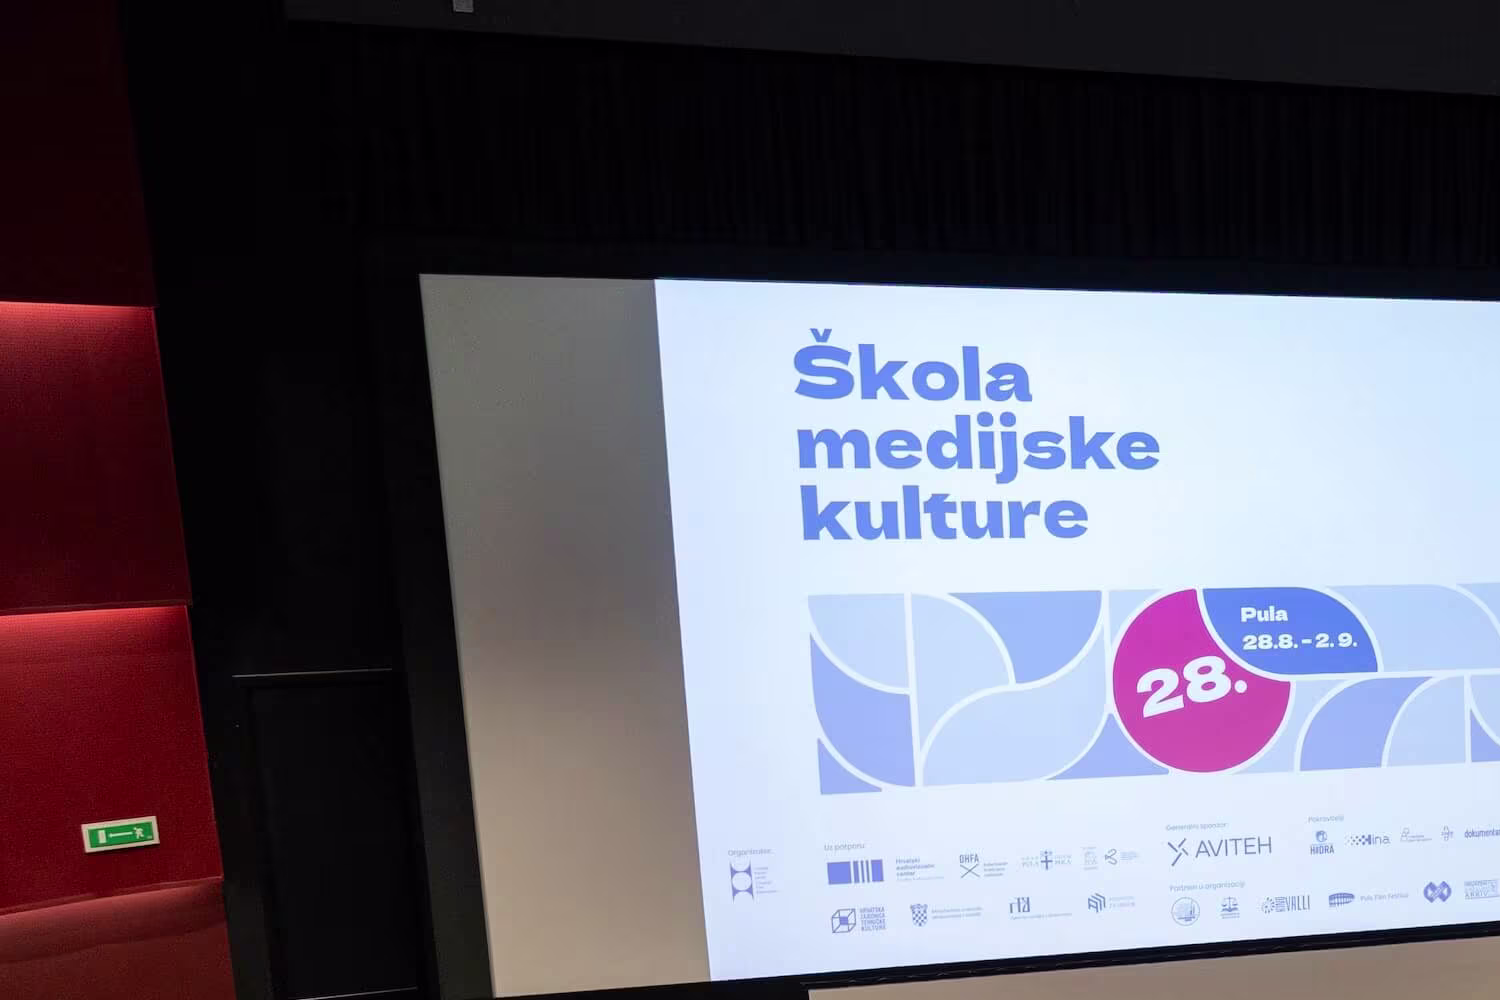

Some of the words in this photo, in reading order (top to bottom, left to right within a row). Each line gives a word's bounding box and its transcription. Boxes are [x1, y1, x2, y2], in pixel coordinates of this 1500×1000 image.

[793, 328, 1032, 402] Škola
[796, 412, 1160, 484] medijske
[800, 484, 1089, 541] kulture
[1240, 605, 1288, 622] Pula
[1136, 655, 1247, 718] 28.
[1195, 836, 1272, 858] AVITEH
